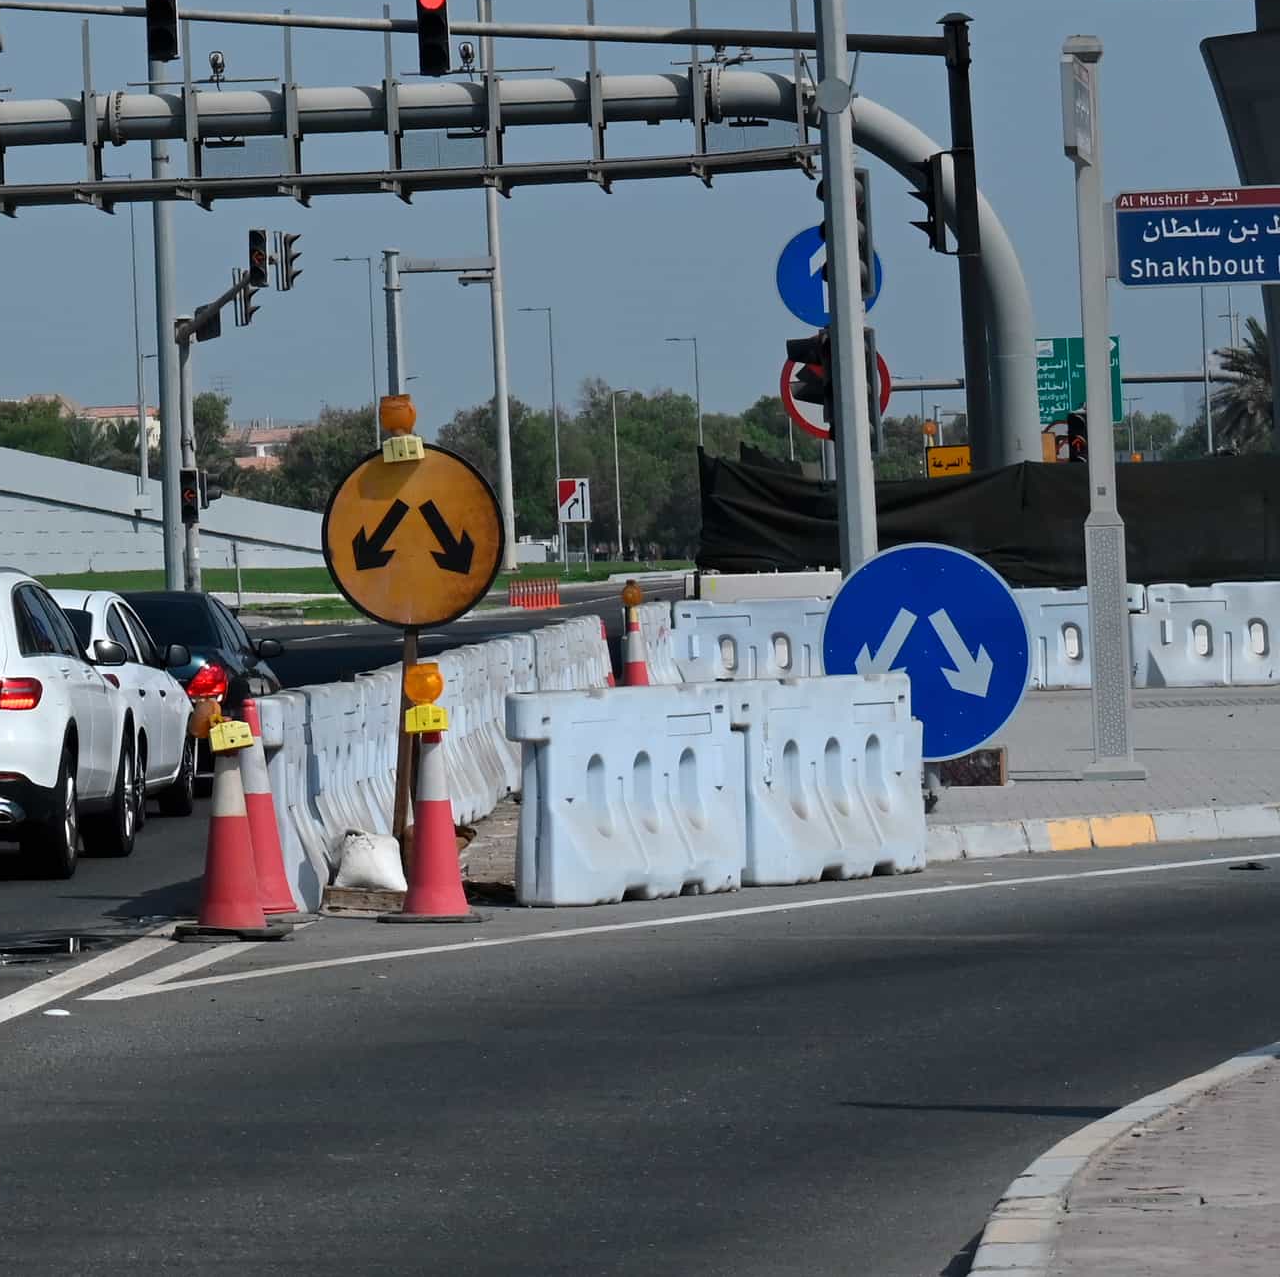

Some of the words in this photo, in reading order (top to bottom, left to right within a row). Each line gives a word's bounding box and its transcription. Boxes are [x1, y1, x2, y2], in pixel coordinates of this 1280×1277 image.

[1120, 195, 1134, 208] Al
[1140, 193, 1189, 207] Mushrif
[1195, 191, 1238, 206] المشرف
[1142, 217, 1221, 243] سلطان
[1227, 219, 1259, 243] بن
[1130, 255, 1265, 279] Shakhbout
